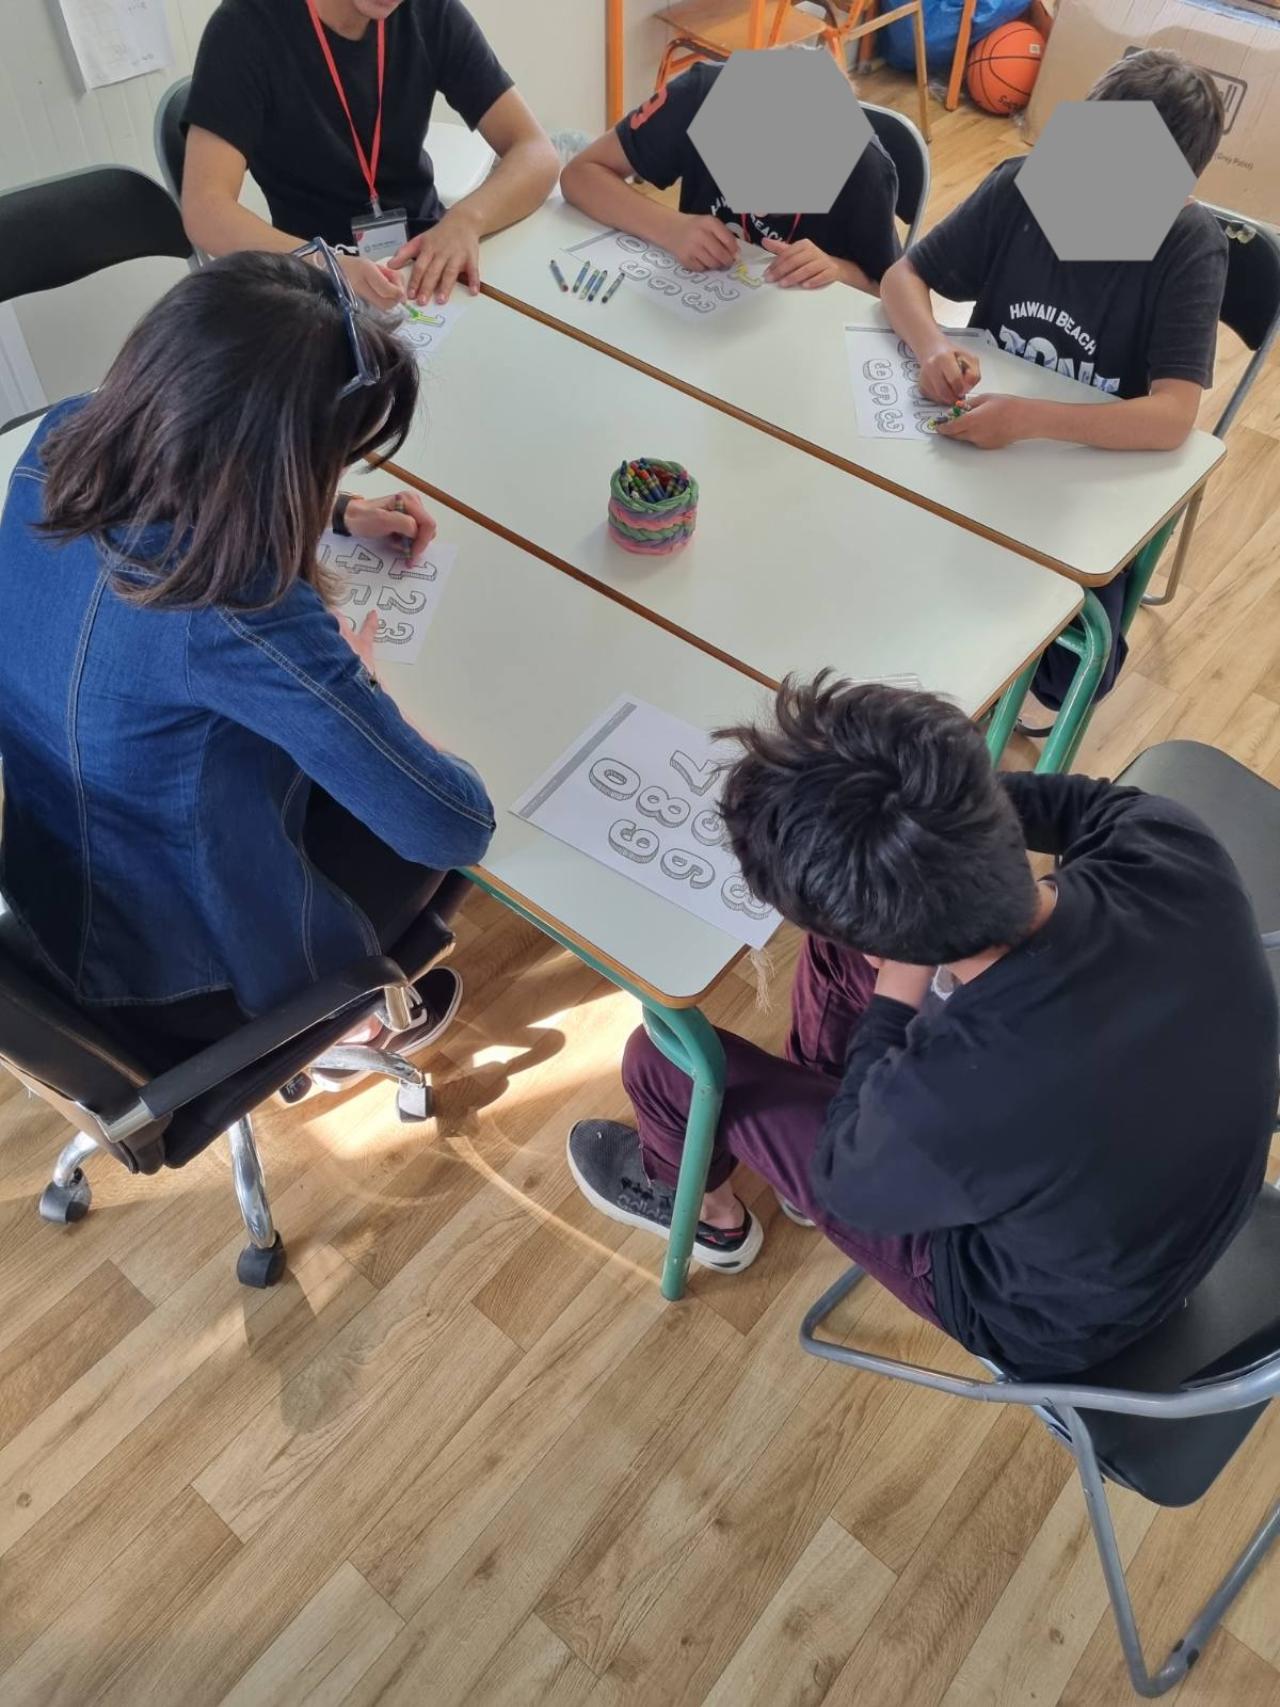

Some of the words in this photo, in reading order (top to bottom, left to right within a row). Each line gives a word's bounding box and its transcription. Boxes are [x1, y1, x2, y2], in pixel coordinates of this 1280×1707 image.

[750, 212, 785, 242] EAC
[616, 234, 649, 254] 0
[681, 291, 716, 313] 3
[705, 279, 740, 301] 2
[1009, 301, 1057, 323] HAWAII
[1056, 310, 1097, 356] BEACH
[875, 408, 905, 433] 3
[335, 543, 384, 574] 4
[388, 557, 437, 582] 1
[376, 585, 428, 615] 2
[373, 619, 415, 645] 3
[588, 757, 641, 801] 0
[669, 750, 721, 796] 7
[636, 785, 691, 828] 8
[608, 818, 660, 864] 9
[660, 848, 715, 890] 6
